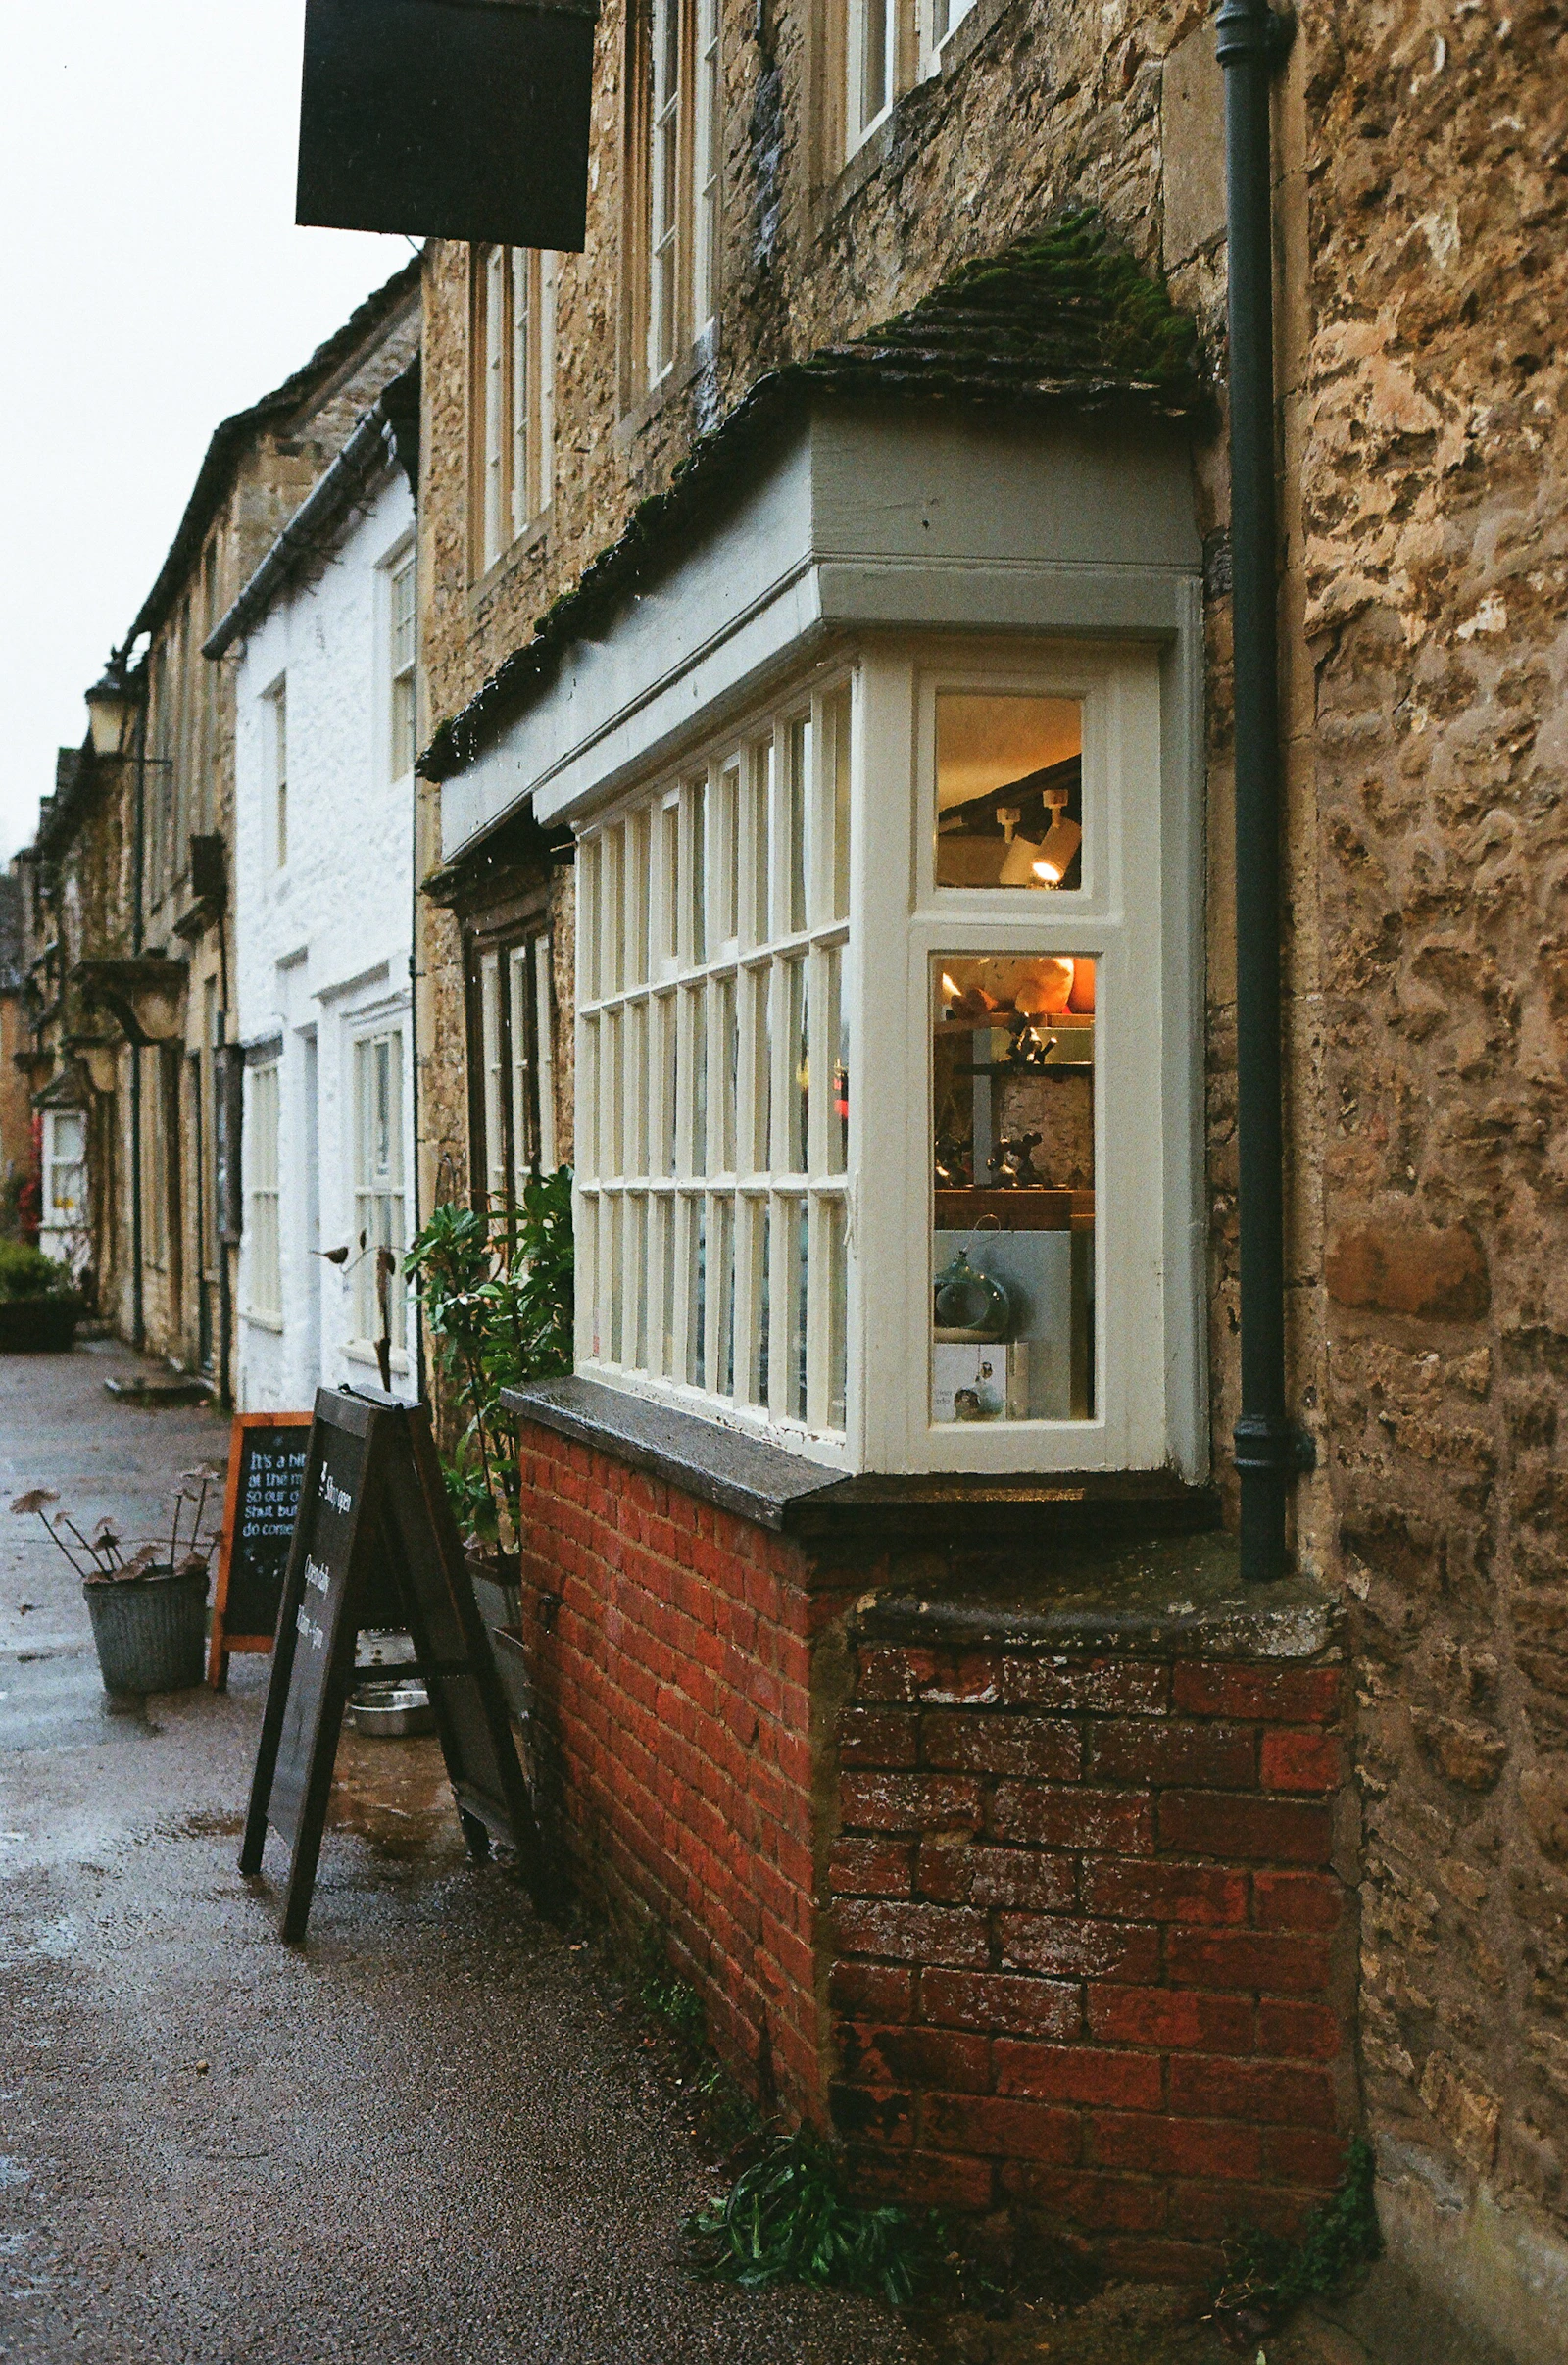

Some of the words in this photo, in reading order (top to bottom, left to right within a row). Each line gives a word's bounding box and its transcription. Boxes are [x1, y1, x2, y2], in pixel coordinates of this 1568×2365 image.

[276, 1455, 286, 1469] a
[248, 1473, 261, 1488] at
[266, 1472, 288, 1487] the
[245, 1490, 262, 1503] so
[264, 1490, 285, 1503] our
[242, 1522, 261, 1537] do
